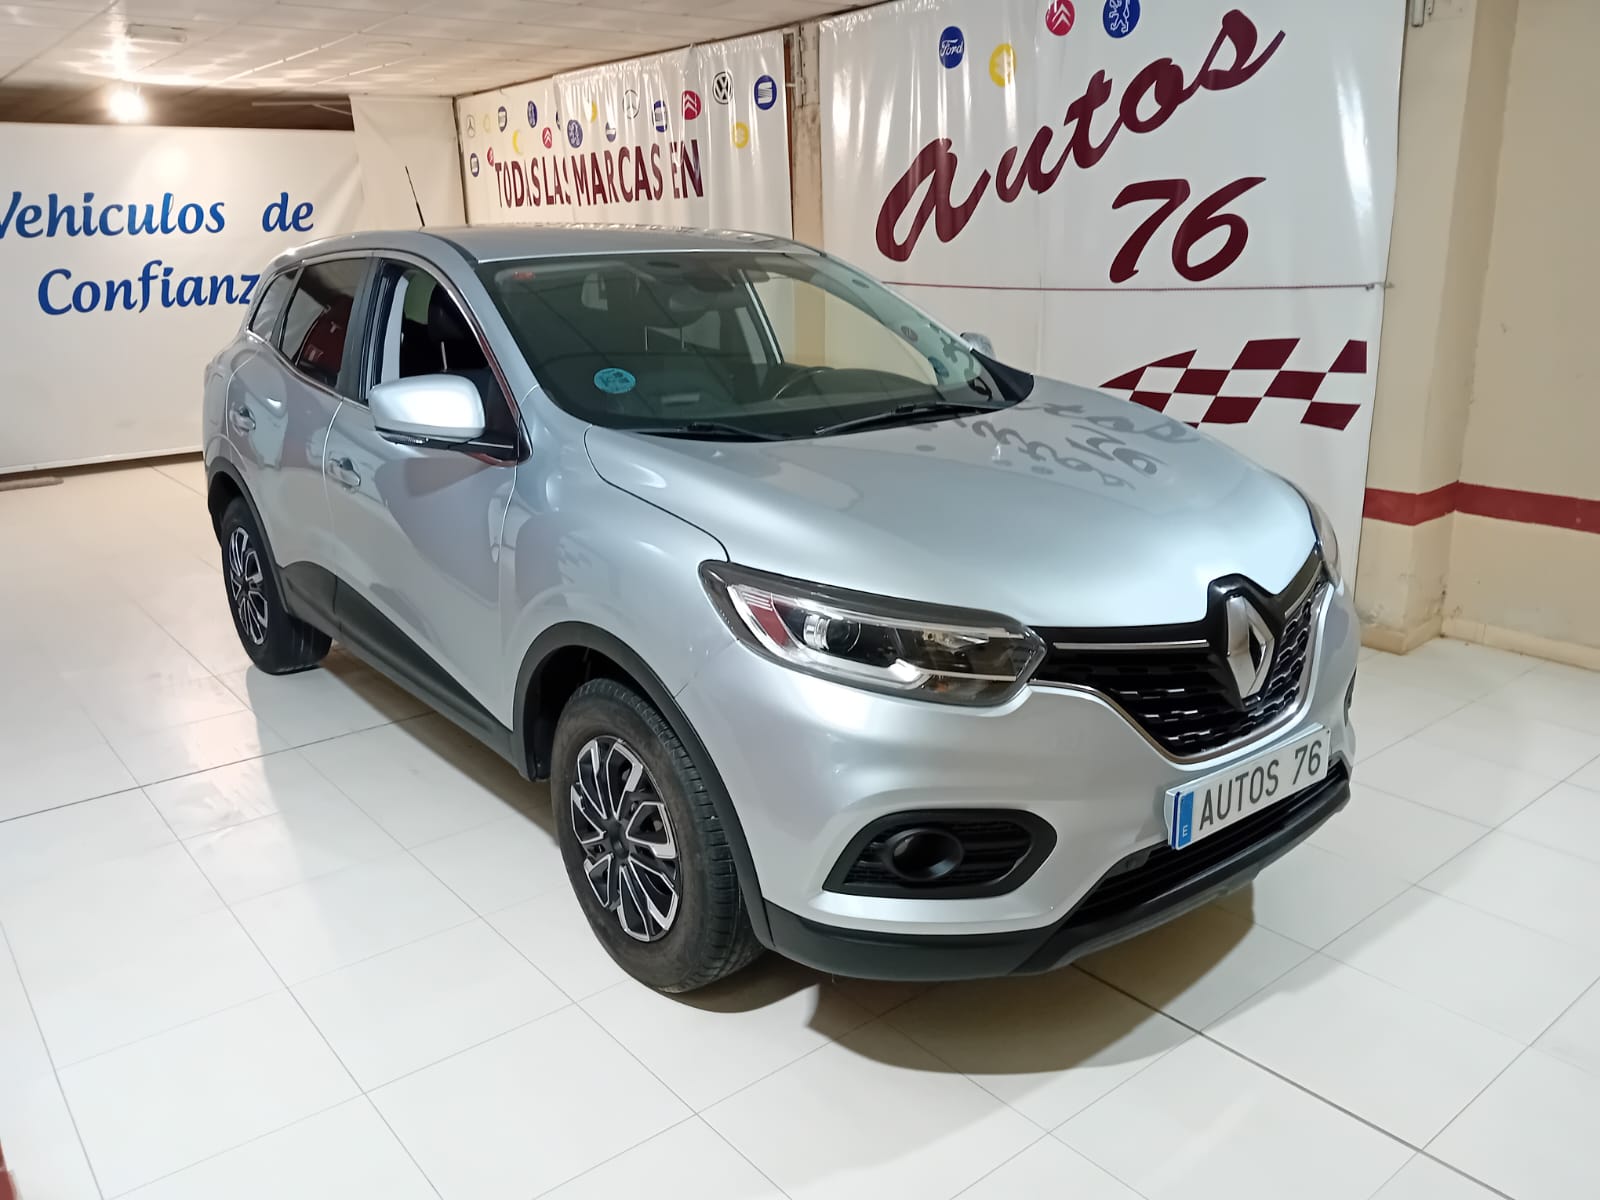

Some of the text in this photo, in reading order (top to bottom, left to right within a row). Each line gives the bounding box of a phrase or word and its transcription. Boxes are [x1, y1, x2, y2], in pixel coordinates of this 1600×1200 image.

[940, 39, 964, 57] Ford
[571, 143, 663, 207] MARCAS
[669, 139, 704, 199] EN
[262, 191, 314, 233] de
[1110, 177, 1266, 283] 76
[1199, 740, 1322, 831] AUTOS 76
[1182, 825, 1188, 837] E
